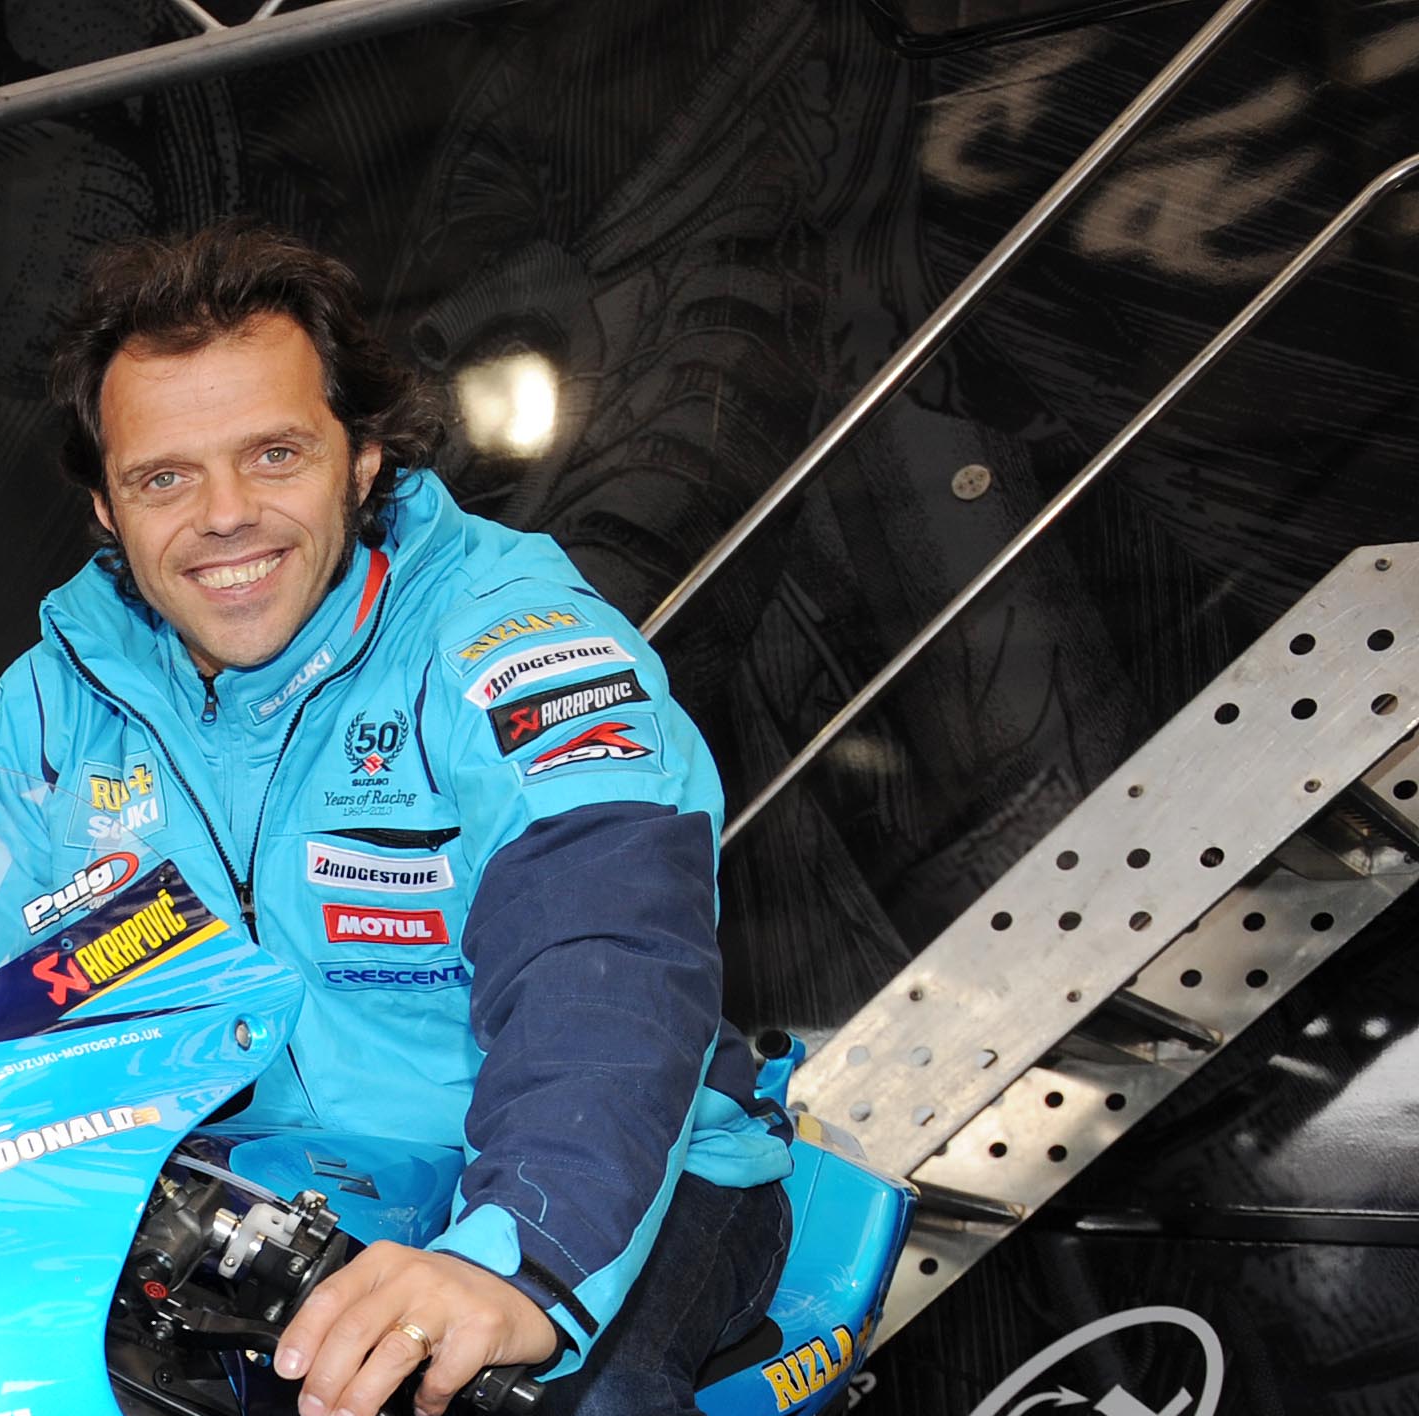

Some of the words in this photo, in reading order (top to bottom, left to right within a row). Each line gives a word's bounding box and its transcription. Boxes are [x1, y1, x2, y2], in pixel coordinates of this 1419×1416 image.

[258, 649, 333, 718] SUZUKI
[483, 644, 616, 701] BRIDGESTONE
[355, 721, 399, 754] 50
[324, 790, 355, 808] Years
[356, 789, 371, 808] of
[372, 787, 418, 808] Racing
[313, 855, 439, 885] BRIDGESTONE
[22, 861, 115, 928] Puig
[335, 913, 433, 939] MOTUL
[324, 963, 464, 986] CRESCENT
